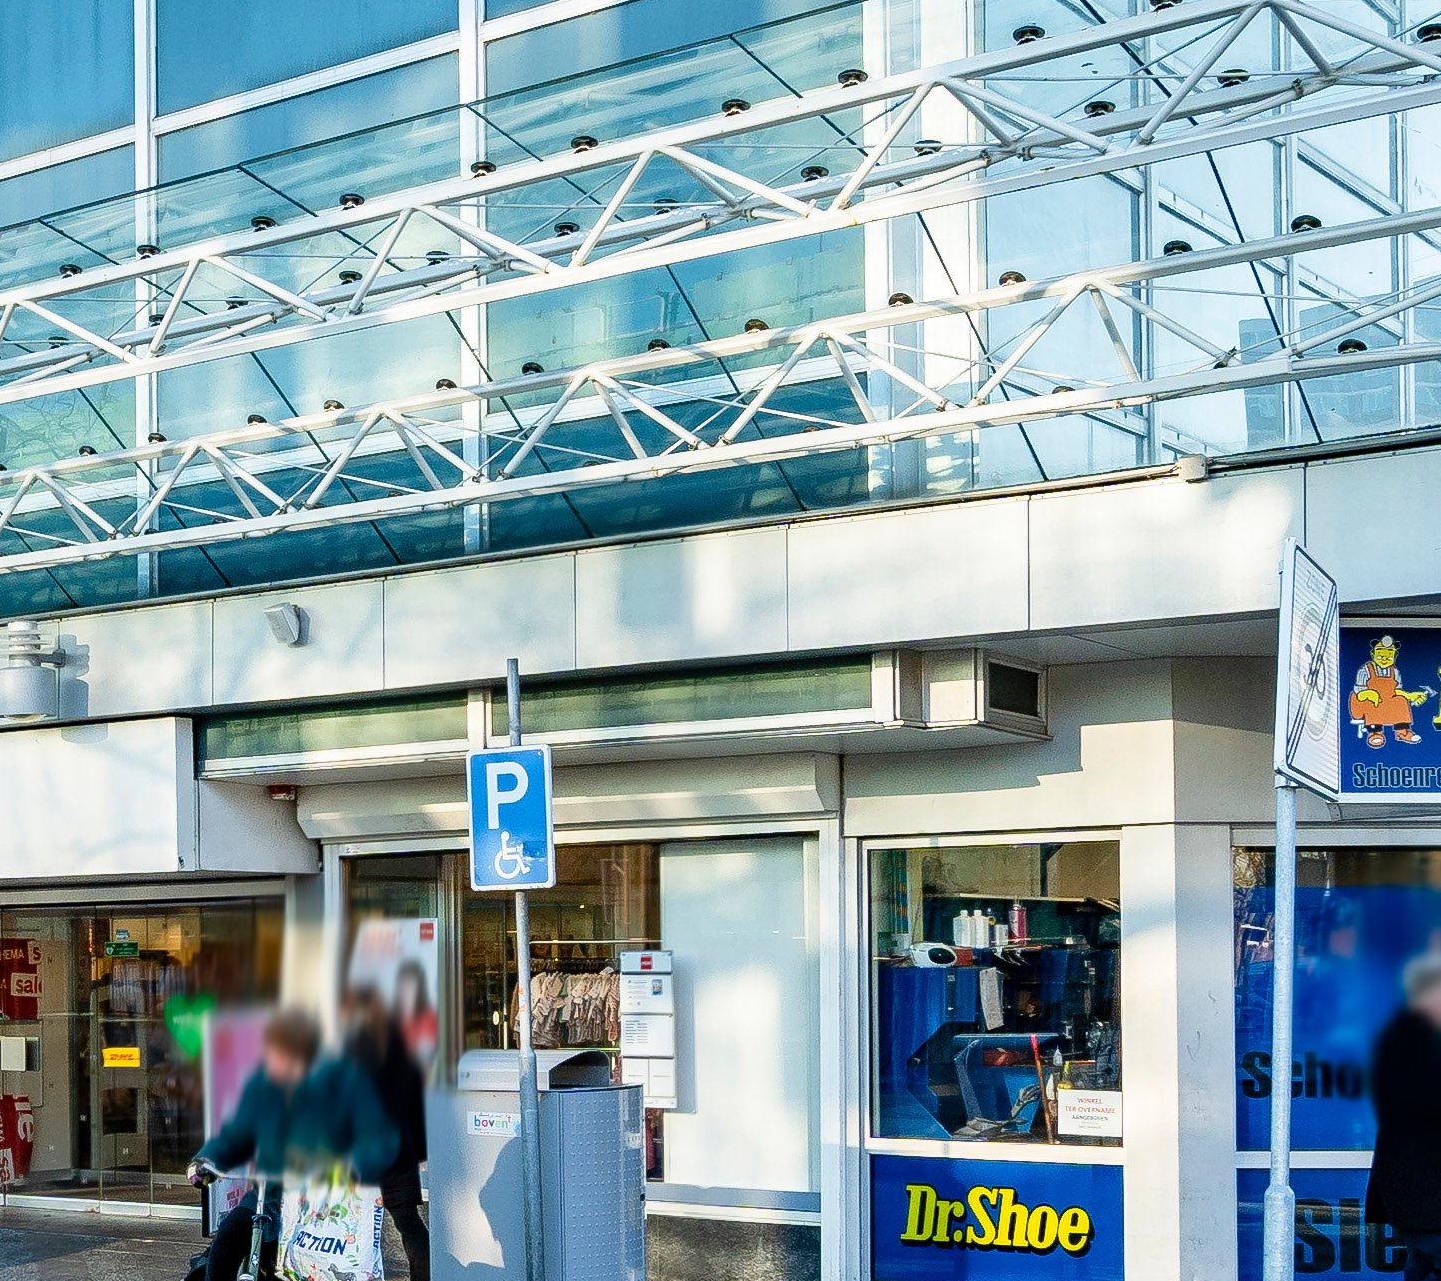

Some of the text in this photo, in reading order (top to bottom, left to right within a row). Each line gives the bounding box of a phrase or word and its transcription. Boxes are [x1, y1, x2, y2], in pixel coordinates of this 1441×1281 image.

[486, 761, 529, 830] P
[0, 949, 25, 961] HEMA
[900, 1183, 1095, 1255] Dr.Shoe
[293, 1230, 348, 1256] ACTION
